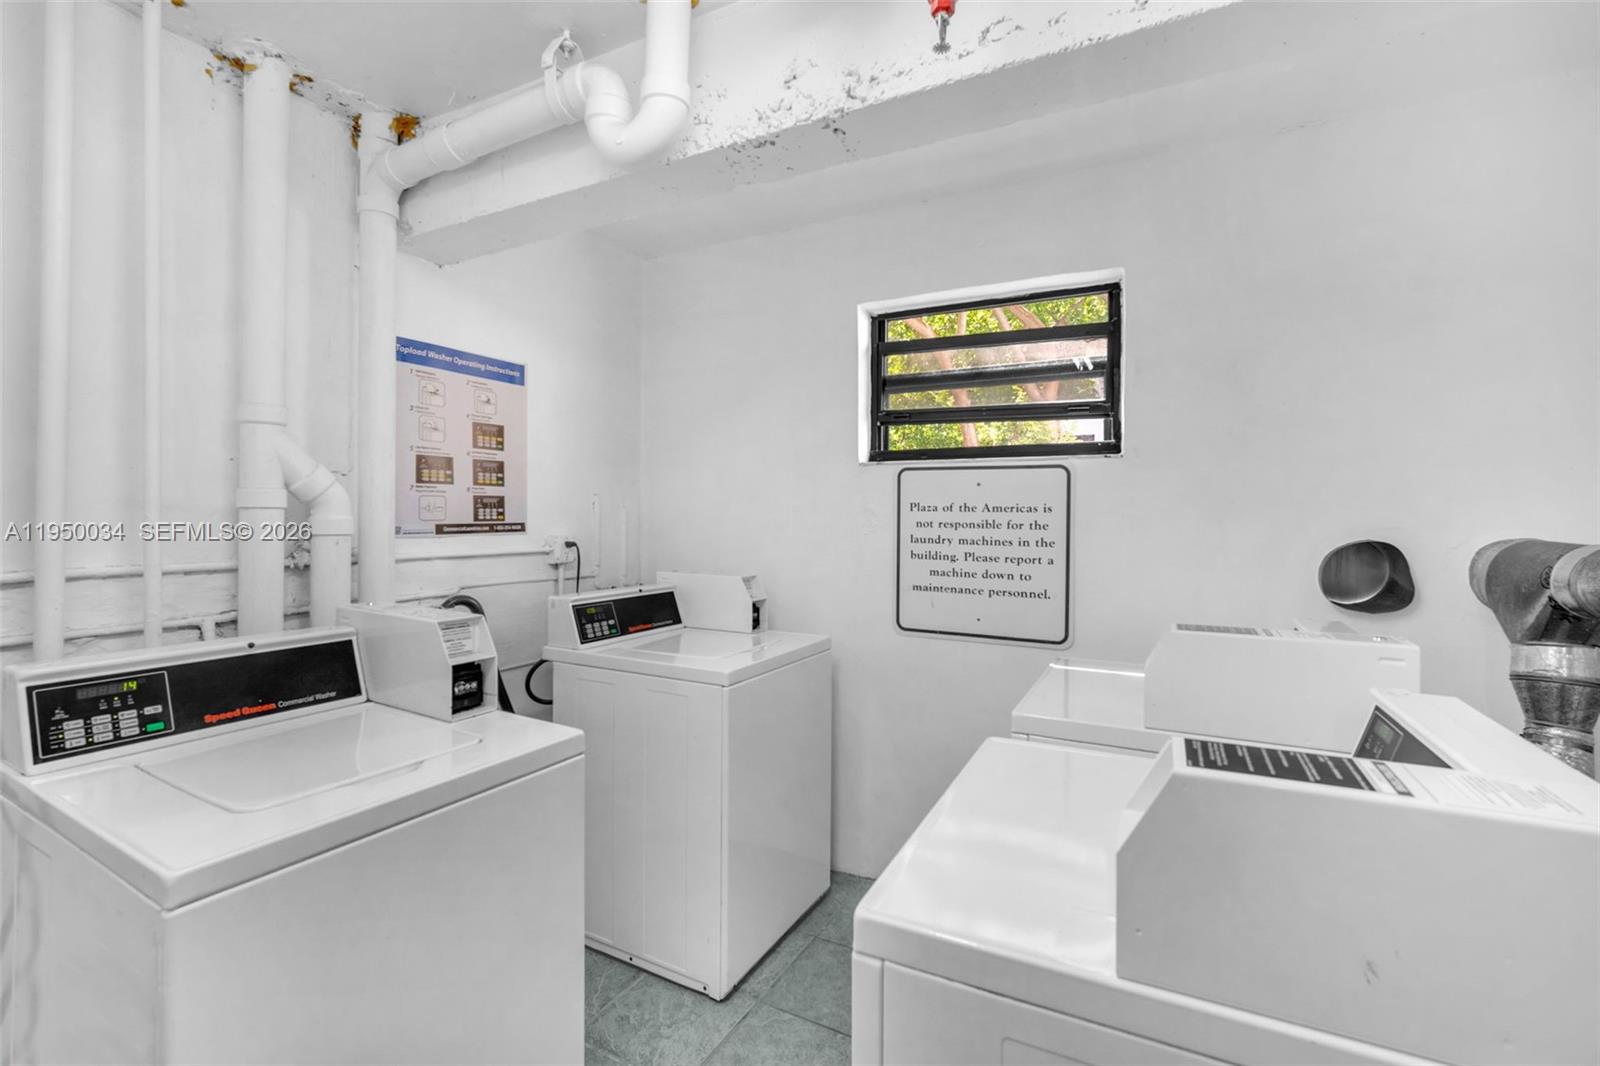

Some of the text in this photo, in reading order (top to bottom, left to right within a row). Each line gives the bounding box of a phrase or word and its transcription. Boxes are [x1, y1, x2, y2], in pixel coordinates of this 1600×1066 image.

[396, 343, 520, 377] Topload Washer Operating Instructions
[909, 502, 1053, 513] Plaza of the Americas is
[916, 519, 1049, 531] not responsible for the
[910, 534, 1056, 549] laundry machines in the
[910, 550, 959, 562] building.
[964, 552, 1000, 564] Please
[1004, 556, 1042, 567] report
[929, 568, 1032, 581] machine down to
[912, 583, 1051, 600] maintenance personnel.
[204, 691, 337, 724] Speed Queen Commercial Washer
